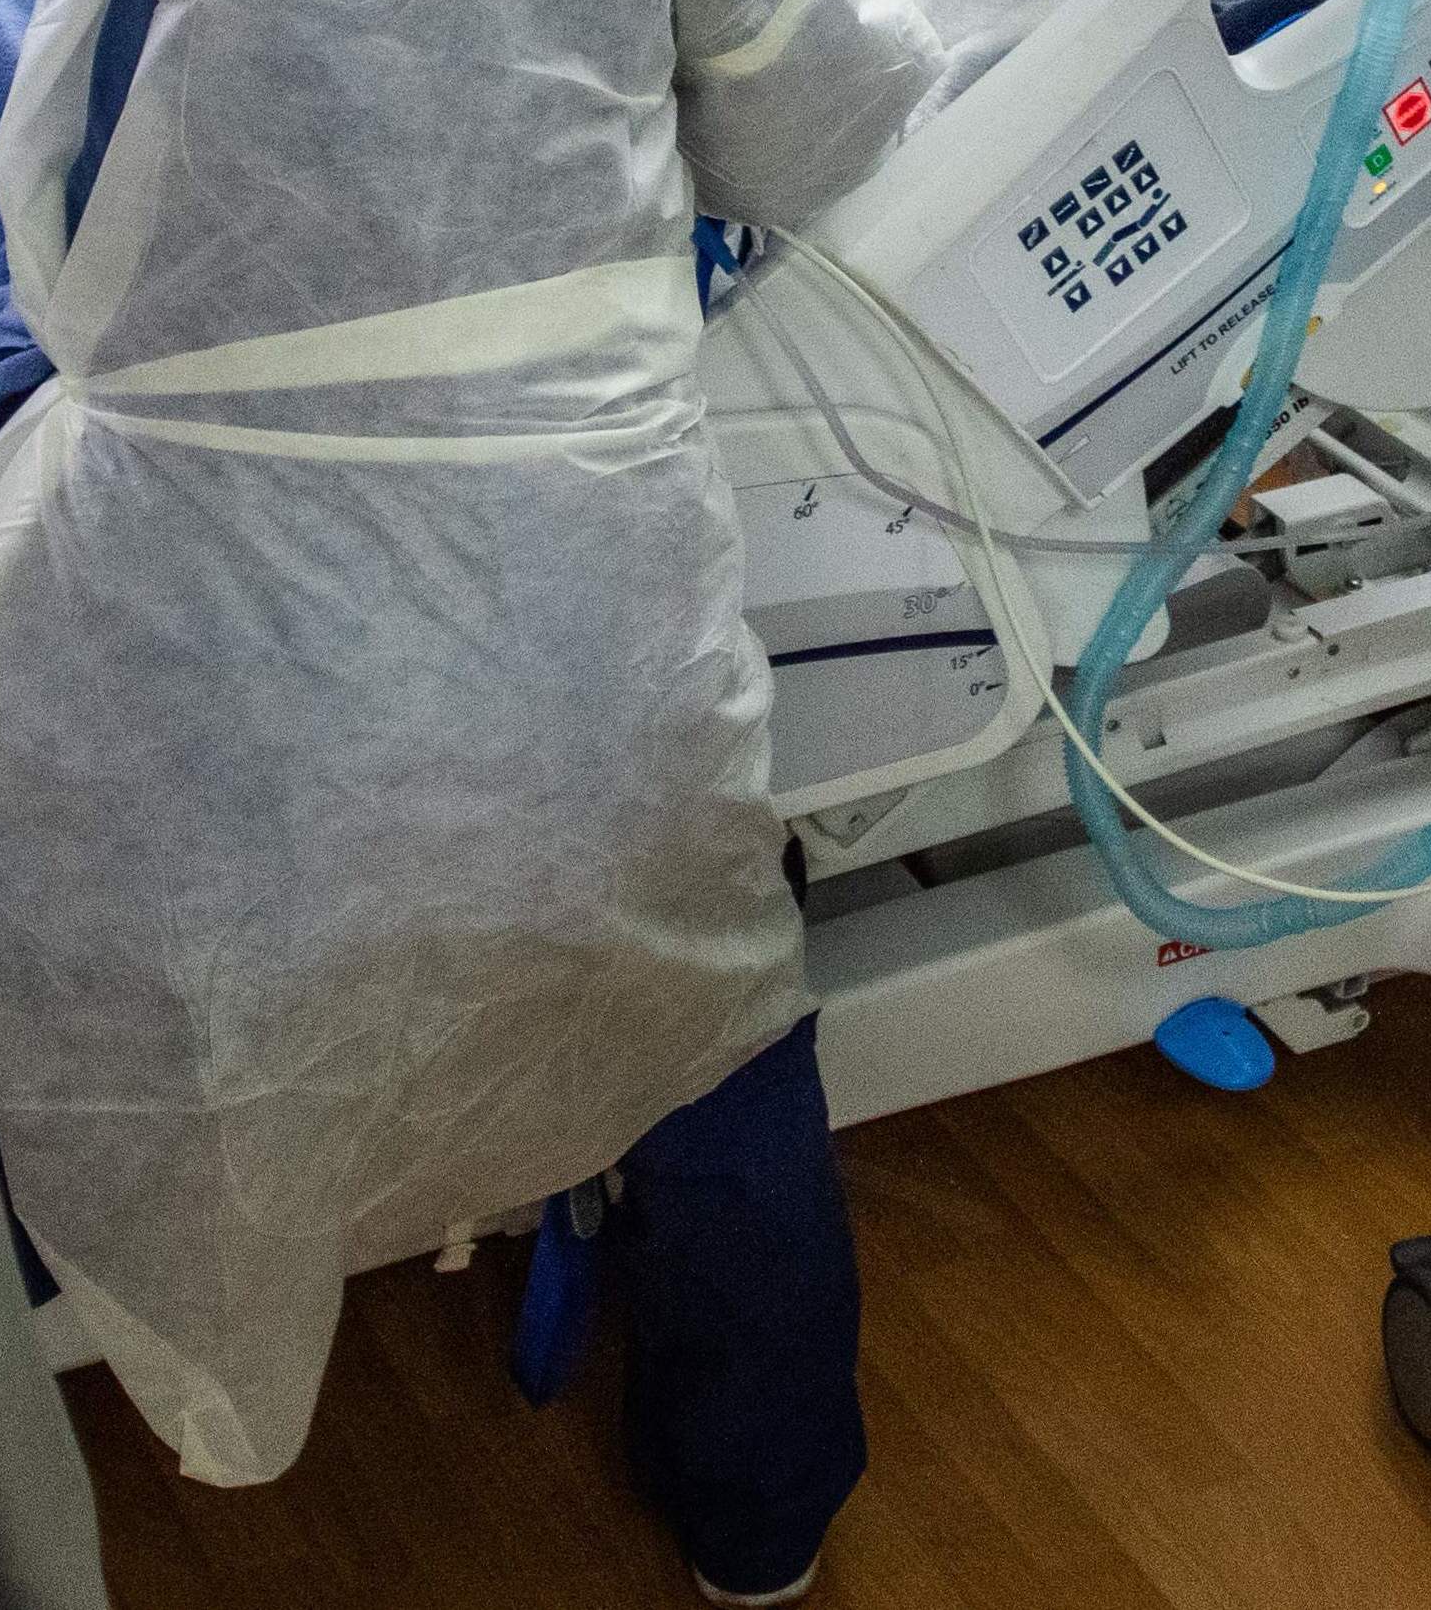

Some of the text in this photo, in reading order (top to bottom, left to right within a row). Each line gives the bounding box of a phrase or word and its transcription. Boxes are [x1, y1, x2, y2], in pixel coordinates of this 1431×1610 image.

[1170, 283, 1276, 375] LIFT TO RELEASE
[1291, 396, 1310, 414] lb
